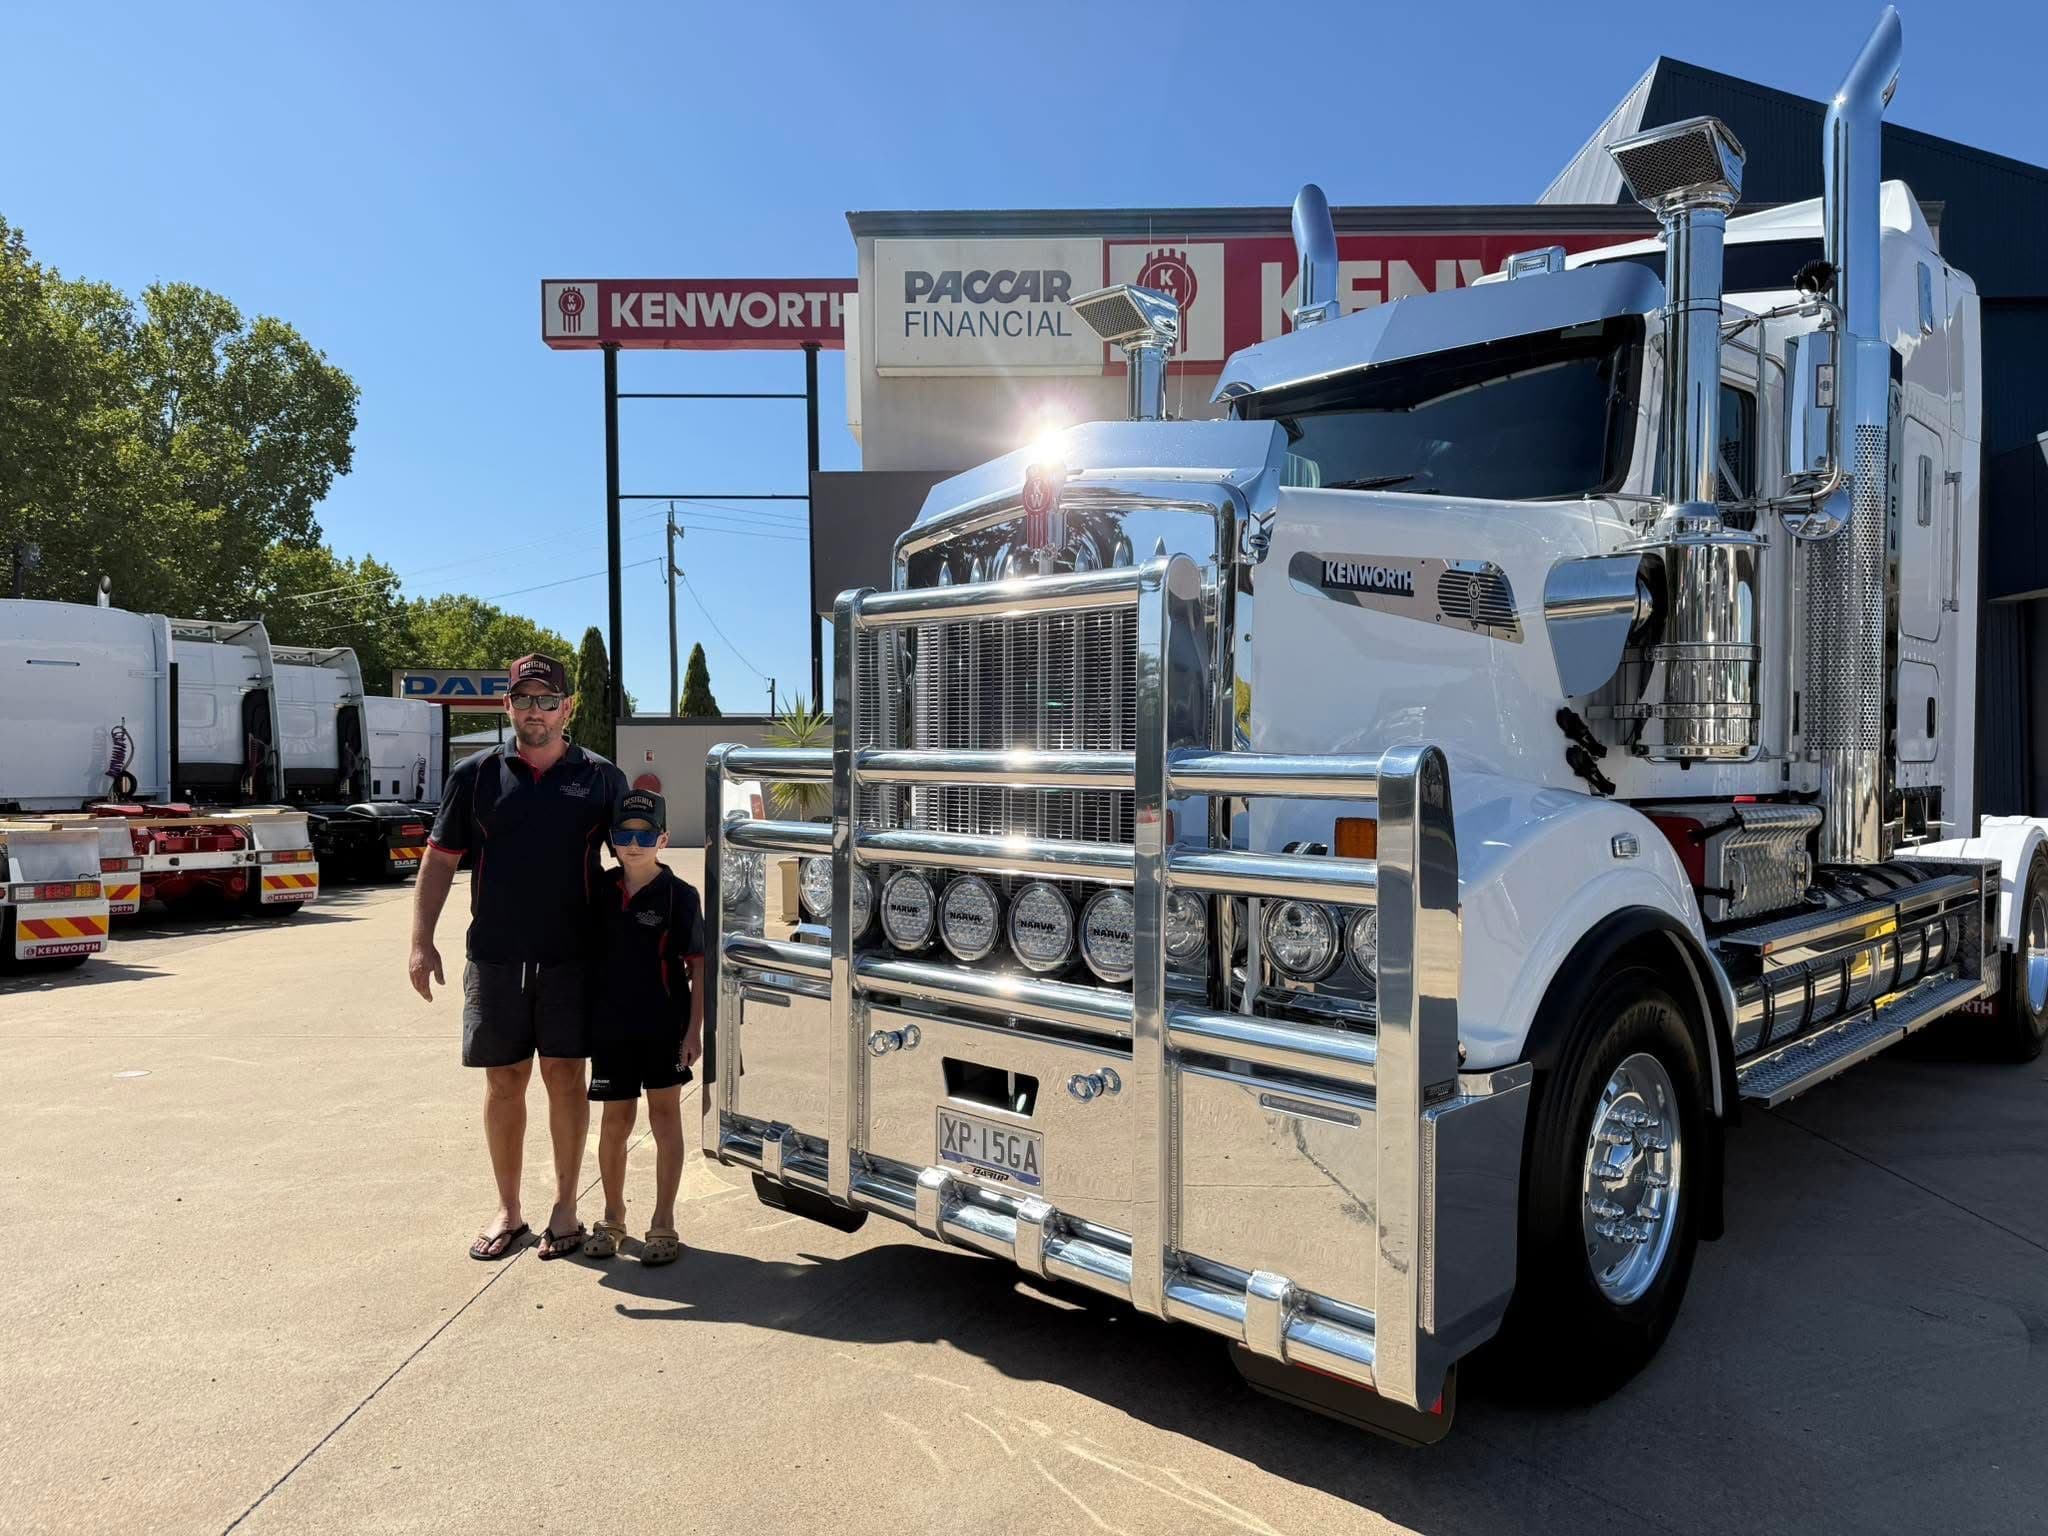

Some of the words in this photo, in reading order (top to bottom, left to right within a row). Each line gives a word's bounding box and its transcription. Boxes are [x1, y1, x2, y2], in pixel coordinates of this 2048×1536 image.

[904, 269, 1072, 304] PACCAR
[904, 310, 1073, 337] FINANCIAL
[1324, 560, 1415, 592] KENWORTH
[404, 676, 511, 696] DAF
[109, 904, 134, 913] ORTH
[1020, 920, 1054, 931] NARVA
[1093, 929, 1127, 940] NARVA
[38, 943, 100, 956] KENWORTH
